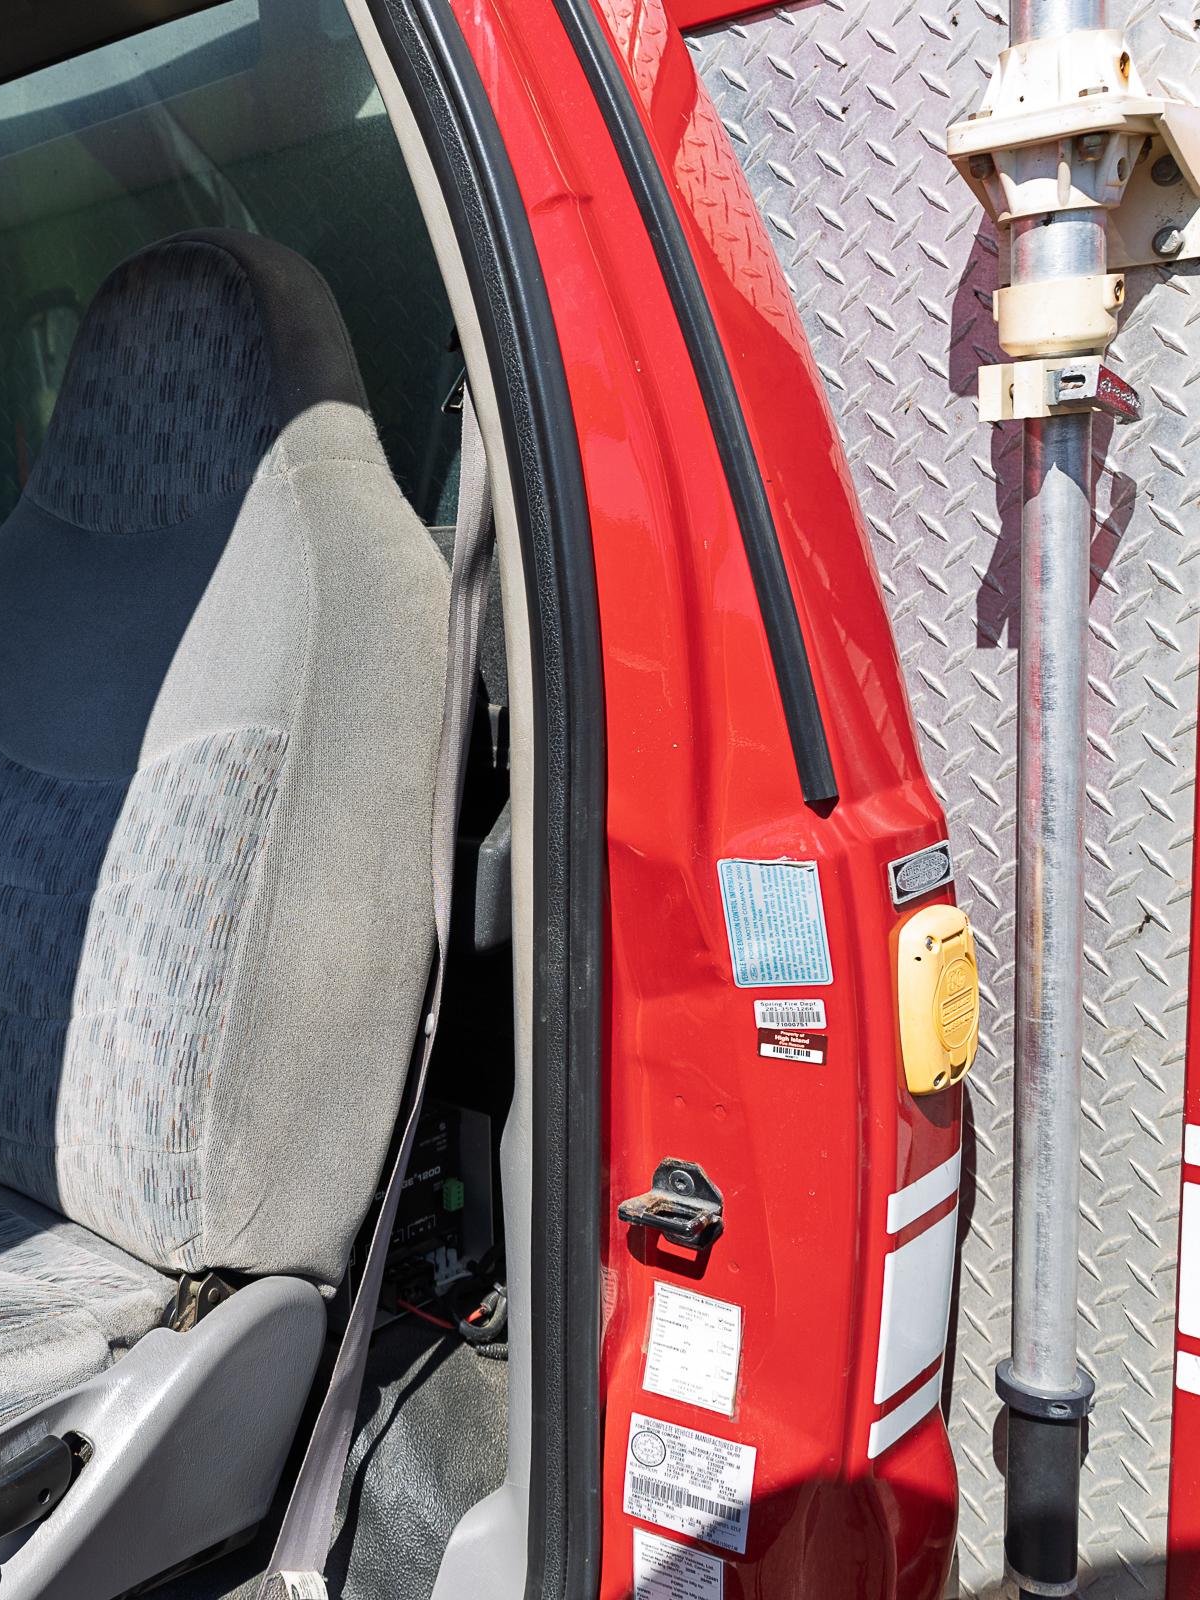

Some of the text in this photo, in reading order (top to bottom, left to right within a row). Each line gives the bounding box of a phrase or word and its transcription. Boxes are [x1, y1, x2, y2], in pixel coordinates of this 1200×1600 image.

[737, 882, 748, 914] COMPANY
[724, 864, 749, 981] VEHICLE NOISE EMISSION CONTROL INFORMATION
[743, 916, 752, 940] MOTOR
[747, 942, 755, 959] FORD
[774, 1034, 810, 1045] High Island
[780, 1030, 799, 1038] Property
[418, 1166, 441, 1182] 1200
[643, 1418, 742, 1453] INCOMPLETE VEHICLE MANUFACTURED BY
[646, 1426, 660, 1434] MOTOR
[661, 1430, 680, 1440] COMPANY
